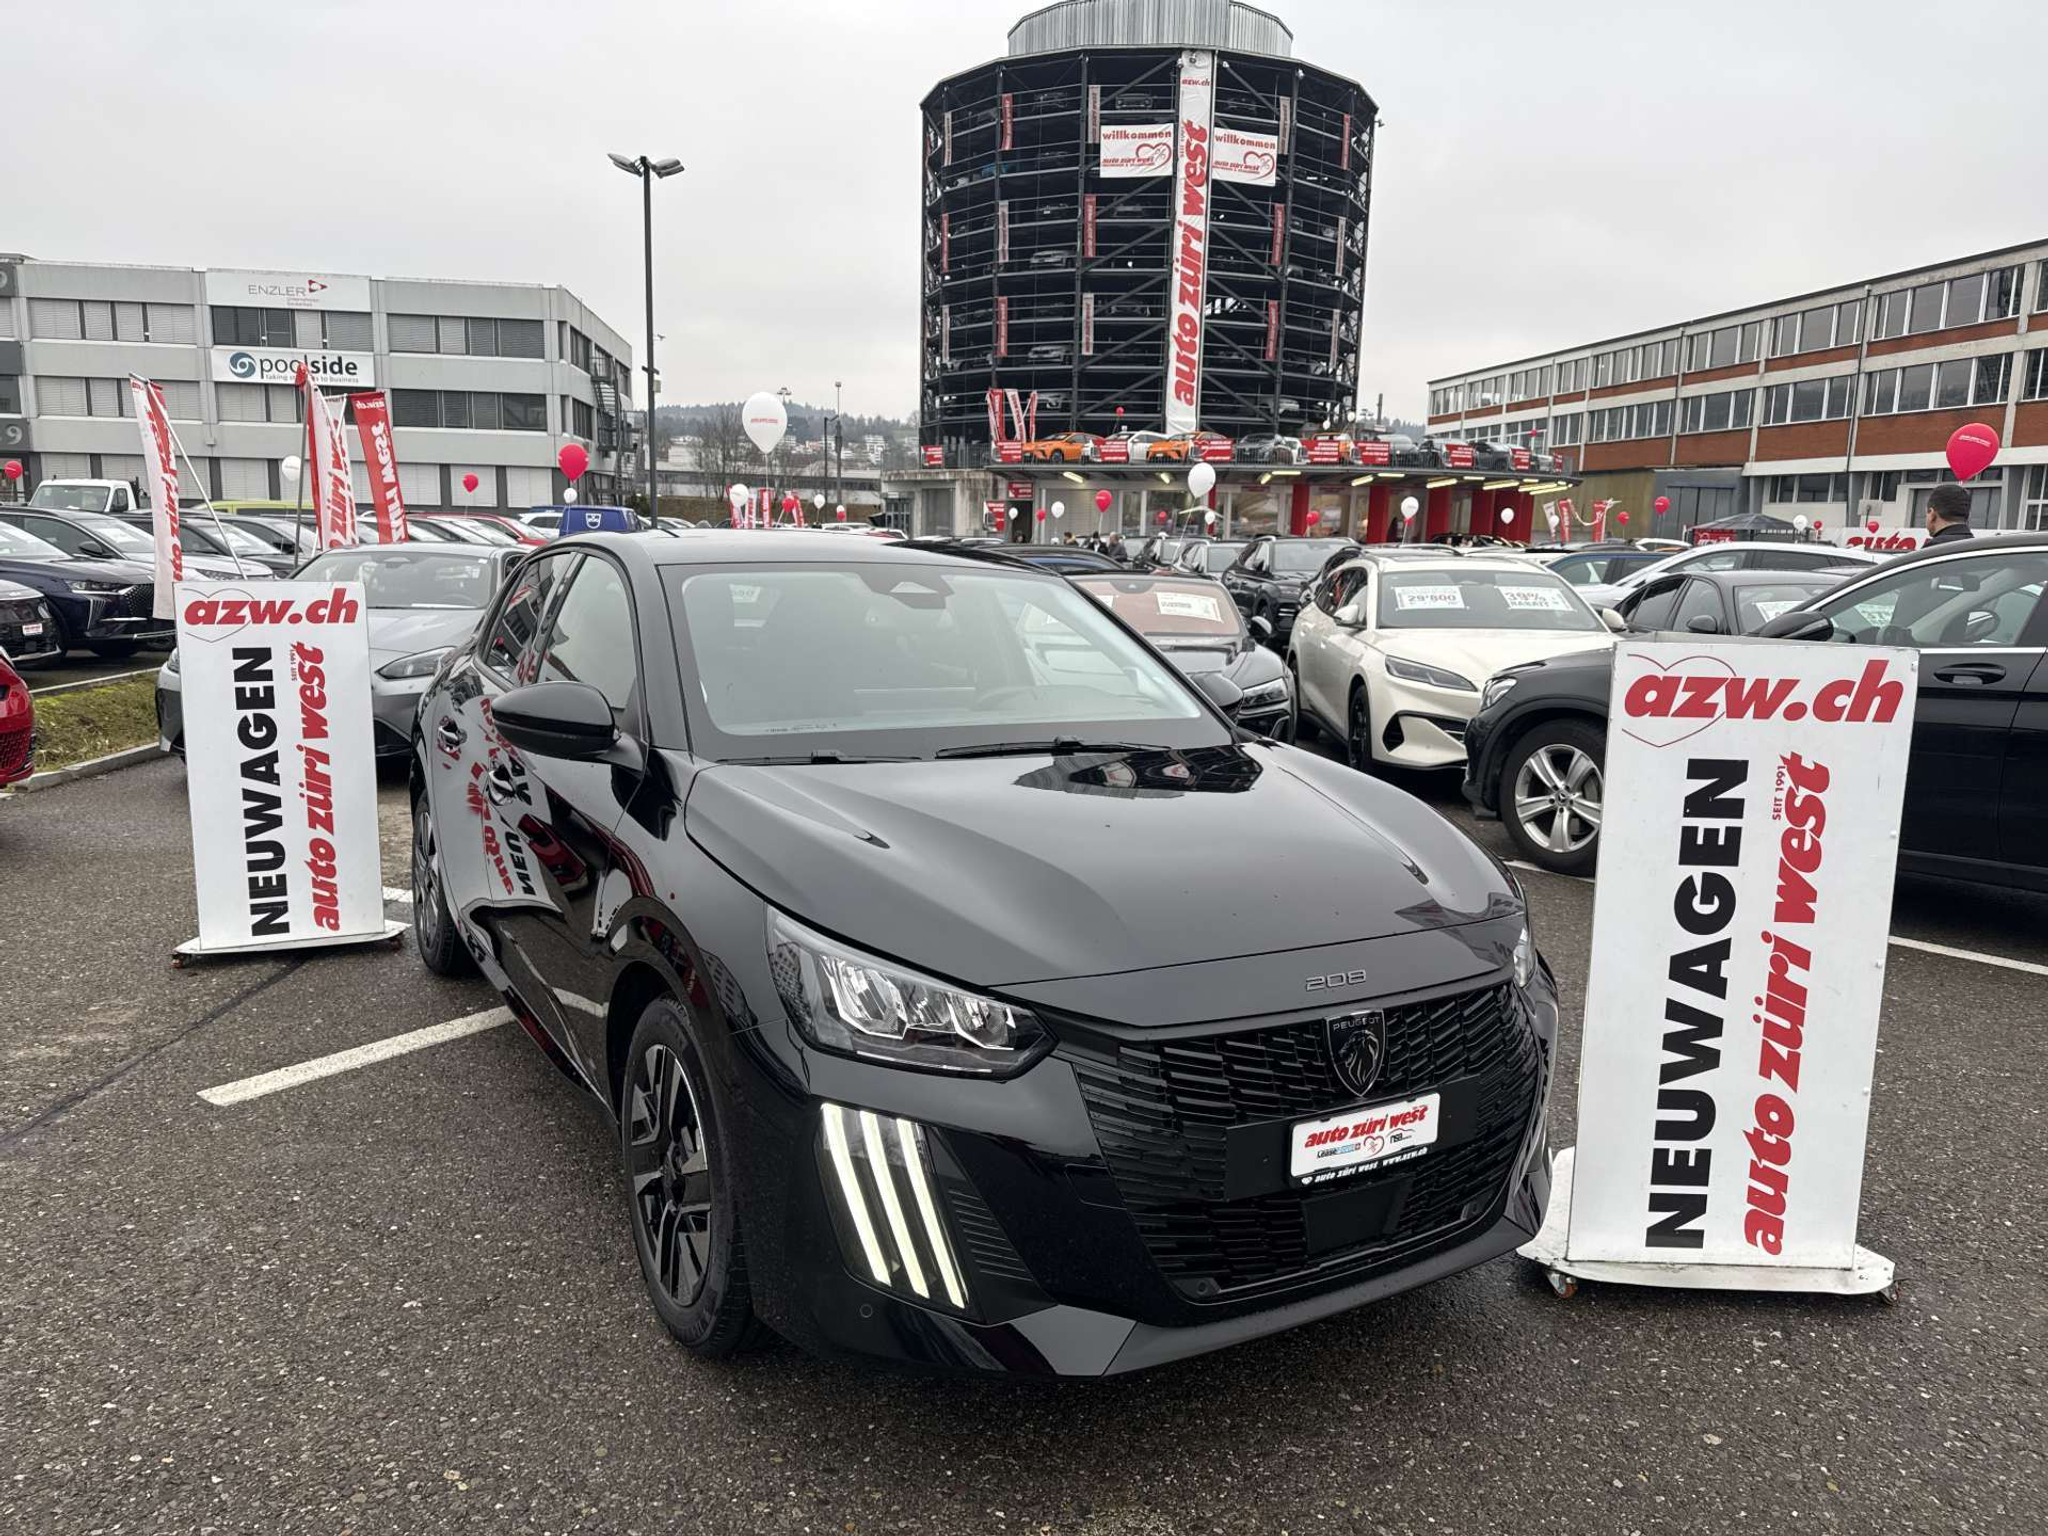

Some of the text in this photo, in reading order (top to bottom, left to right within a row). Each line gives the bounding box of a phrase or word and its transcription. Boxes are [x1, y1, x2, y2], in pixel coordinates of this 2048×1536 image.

[1181, 78, 1210, 87] azw.ch
[1103, 130, 1172, 141] willkommen
[1215, 134, 1276, 149] willkommen
[1173, 119, 1208, 407] auto züri west
[248, 284, 307, 297] ENZLER
[259, 354, 358, 380] poolside
[184, 587, 359, 625] azw.ch
[1622, 659, 1905, 723] azw.ch
[232, 646, 292, 937] NEUWAGEN
[291, 641, 341, 932] auto züri west
[1772, 764, 1786, 821] SEIT 1991
[1306, 969, 1367, 991] 208
[1645, 758, 1749, 1250] NEUWAGEN
[1743, 751, 1831, 1256] auto züri west
[1333, 1016, 1380, 1031] PEUGEOT
[1304, 1104, 1429, 1148] auto züri west
[1314, 1171, 1336, 1183] auto
